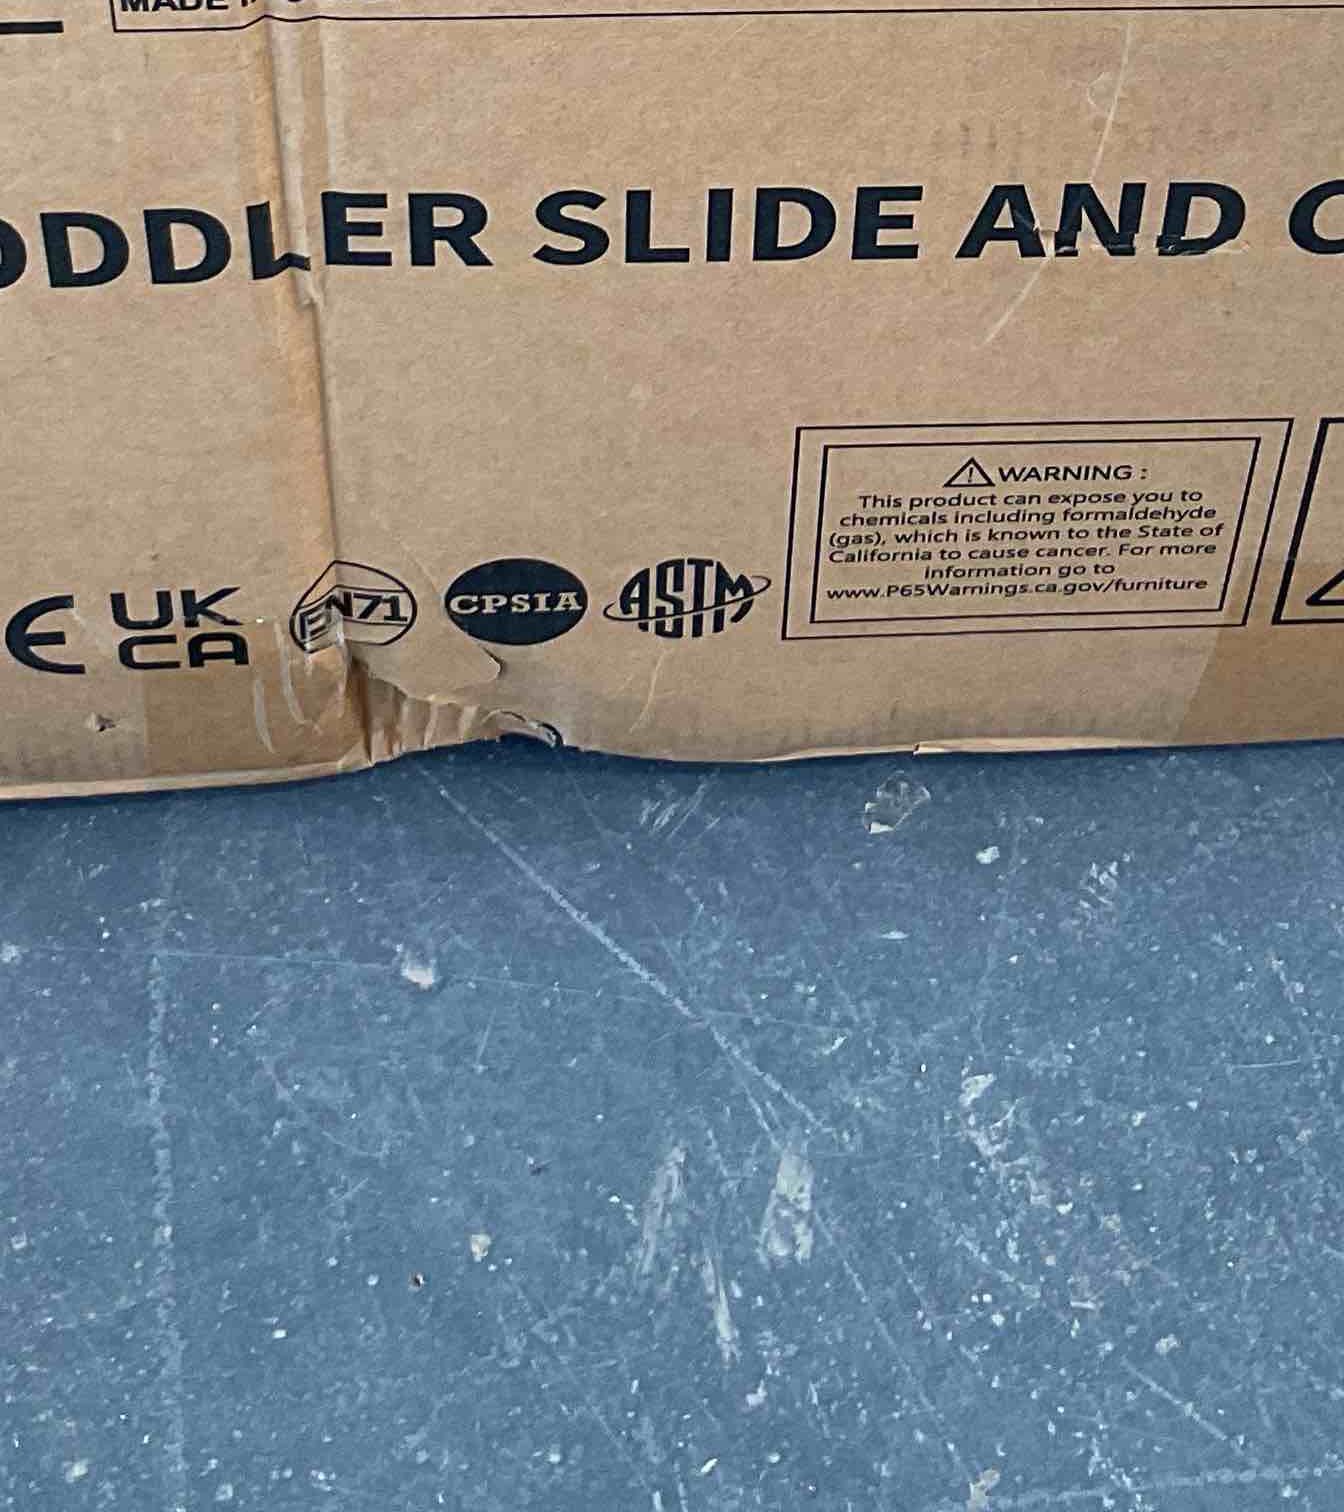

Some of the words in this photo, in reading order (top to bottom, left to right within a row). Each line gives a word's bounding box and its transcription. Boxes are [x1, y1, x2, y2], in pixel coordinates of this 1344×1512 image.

[532, 185, 924, 266] SLIDE
[955, 182, 1246, 259] AND
[998, 464, 1132, 483] WARNING
[858, 494, 902, 509] This
[909, 493, 997, 512] product
[1003, 494, 1041, 506] can
[1047, 492, 1127, 508] expose
[1132, 490, 1176, 506] you
[1180, 490, 1203, 502] to
[839, 511, 948, 527] chemicals
[954, 509, 1056, 526] including
[1062, 505, 1217, 523] formaldehyde
[829, 531, 886, 549] (gas),
[894, 529, 958, 544] which
[965, 528, 981, 543] is
[987, 528, 1060, 542] known
[1067, 527, 1090, 540] to
[1096, 525, 1132, 539] the
[1137, 525, 1194, 539] State
[1199, 522, 1225, 537] of
[828, 548, 932, 564] California
[939, 549, 962, 561] to
[967, 548, 1030, 560] cause
[1035, 546, 1111, 558] cancer.
[1118, 543, 1154, 556] For
[1159, 544, 1217, 556] more
[924, 563, 1051, 580] information
[1058, 565, 1087, 579] go
[1093, 563, 1116, 575] to
[109, 587, 243, 631] UK
[449, 591, 583, 615] CPSIA
[619, 557, 754, 640] ASTM
[118, 632, 250, 671] CA
